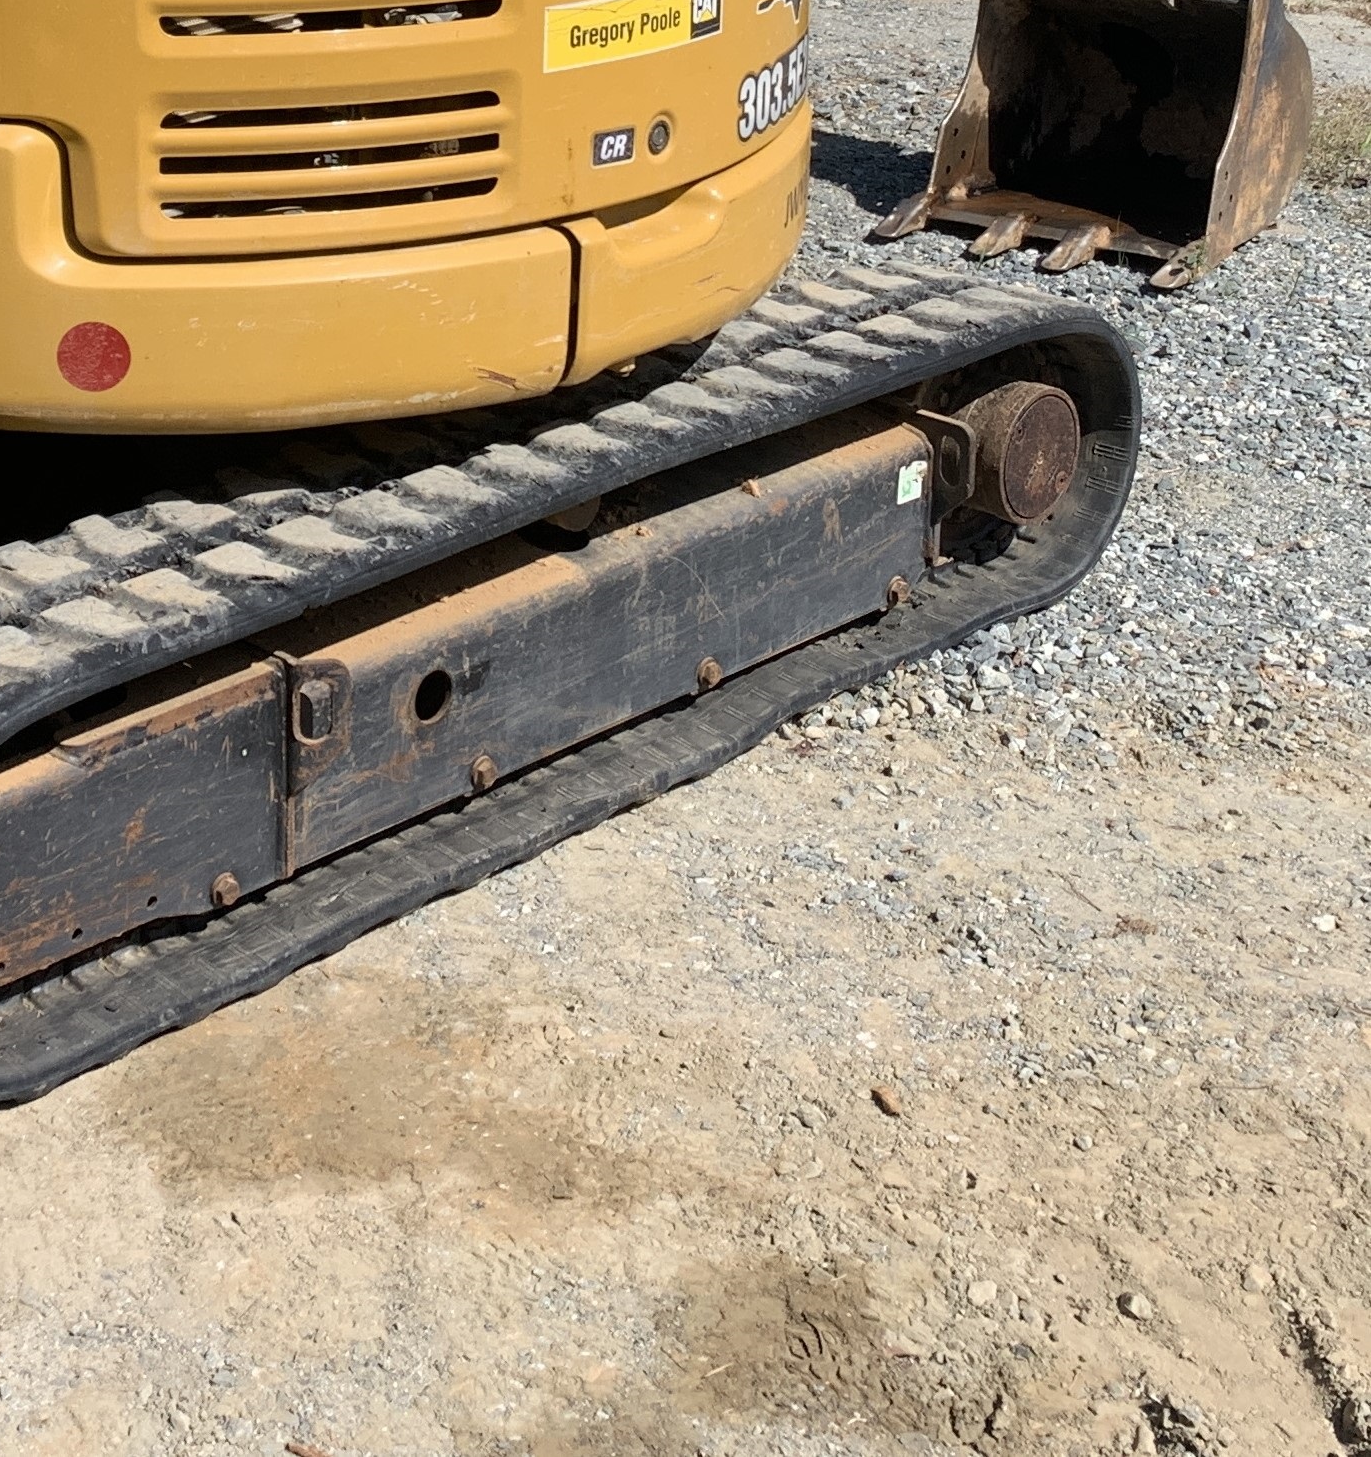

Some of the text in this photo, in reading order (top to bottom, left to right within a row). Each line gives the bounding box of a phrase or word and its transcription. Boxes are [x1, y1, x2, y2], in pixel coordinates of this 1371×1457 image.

[570, 20, 635, 48] Gregory
[640, 7, 681, 35] Poole
[600, 134, 628, 161] CR
